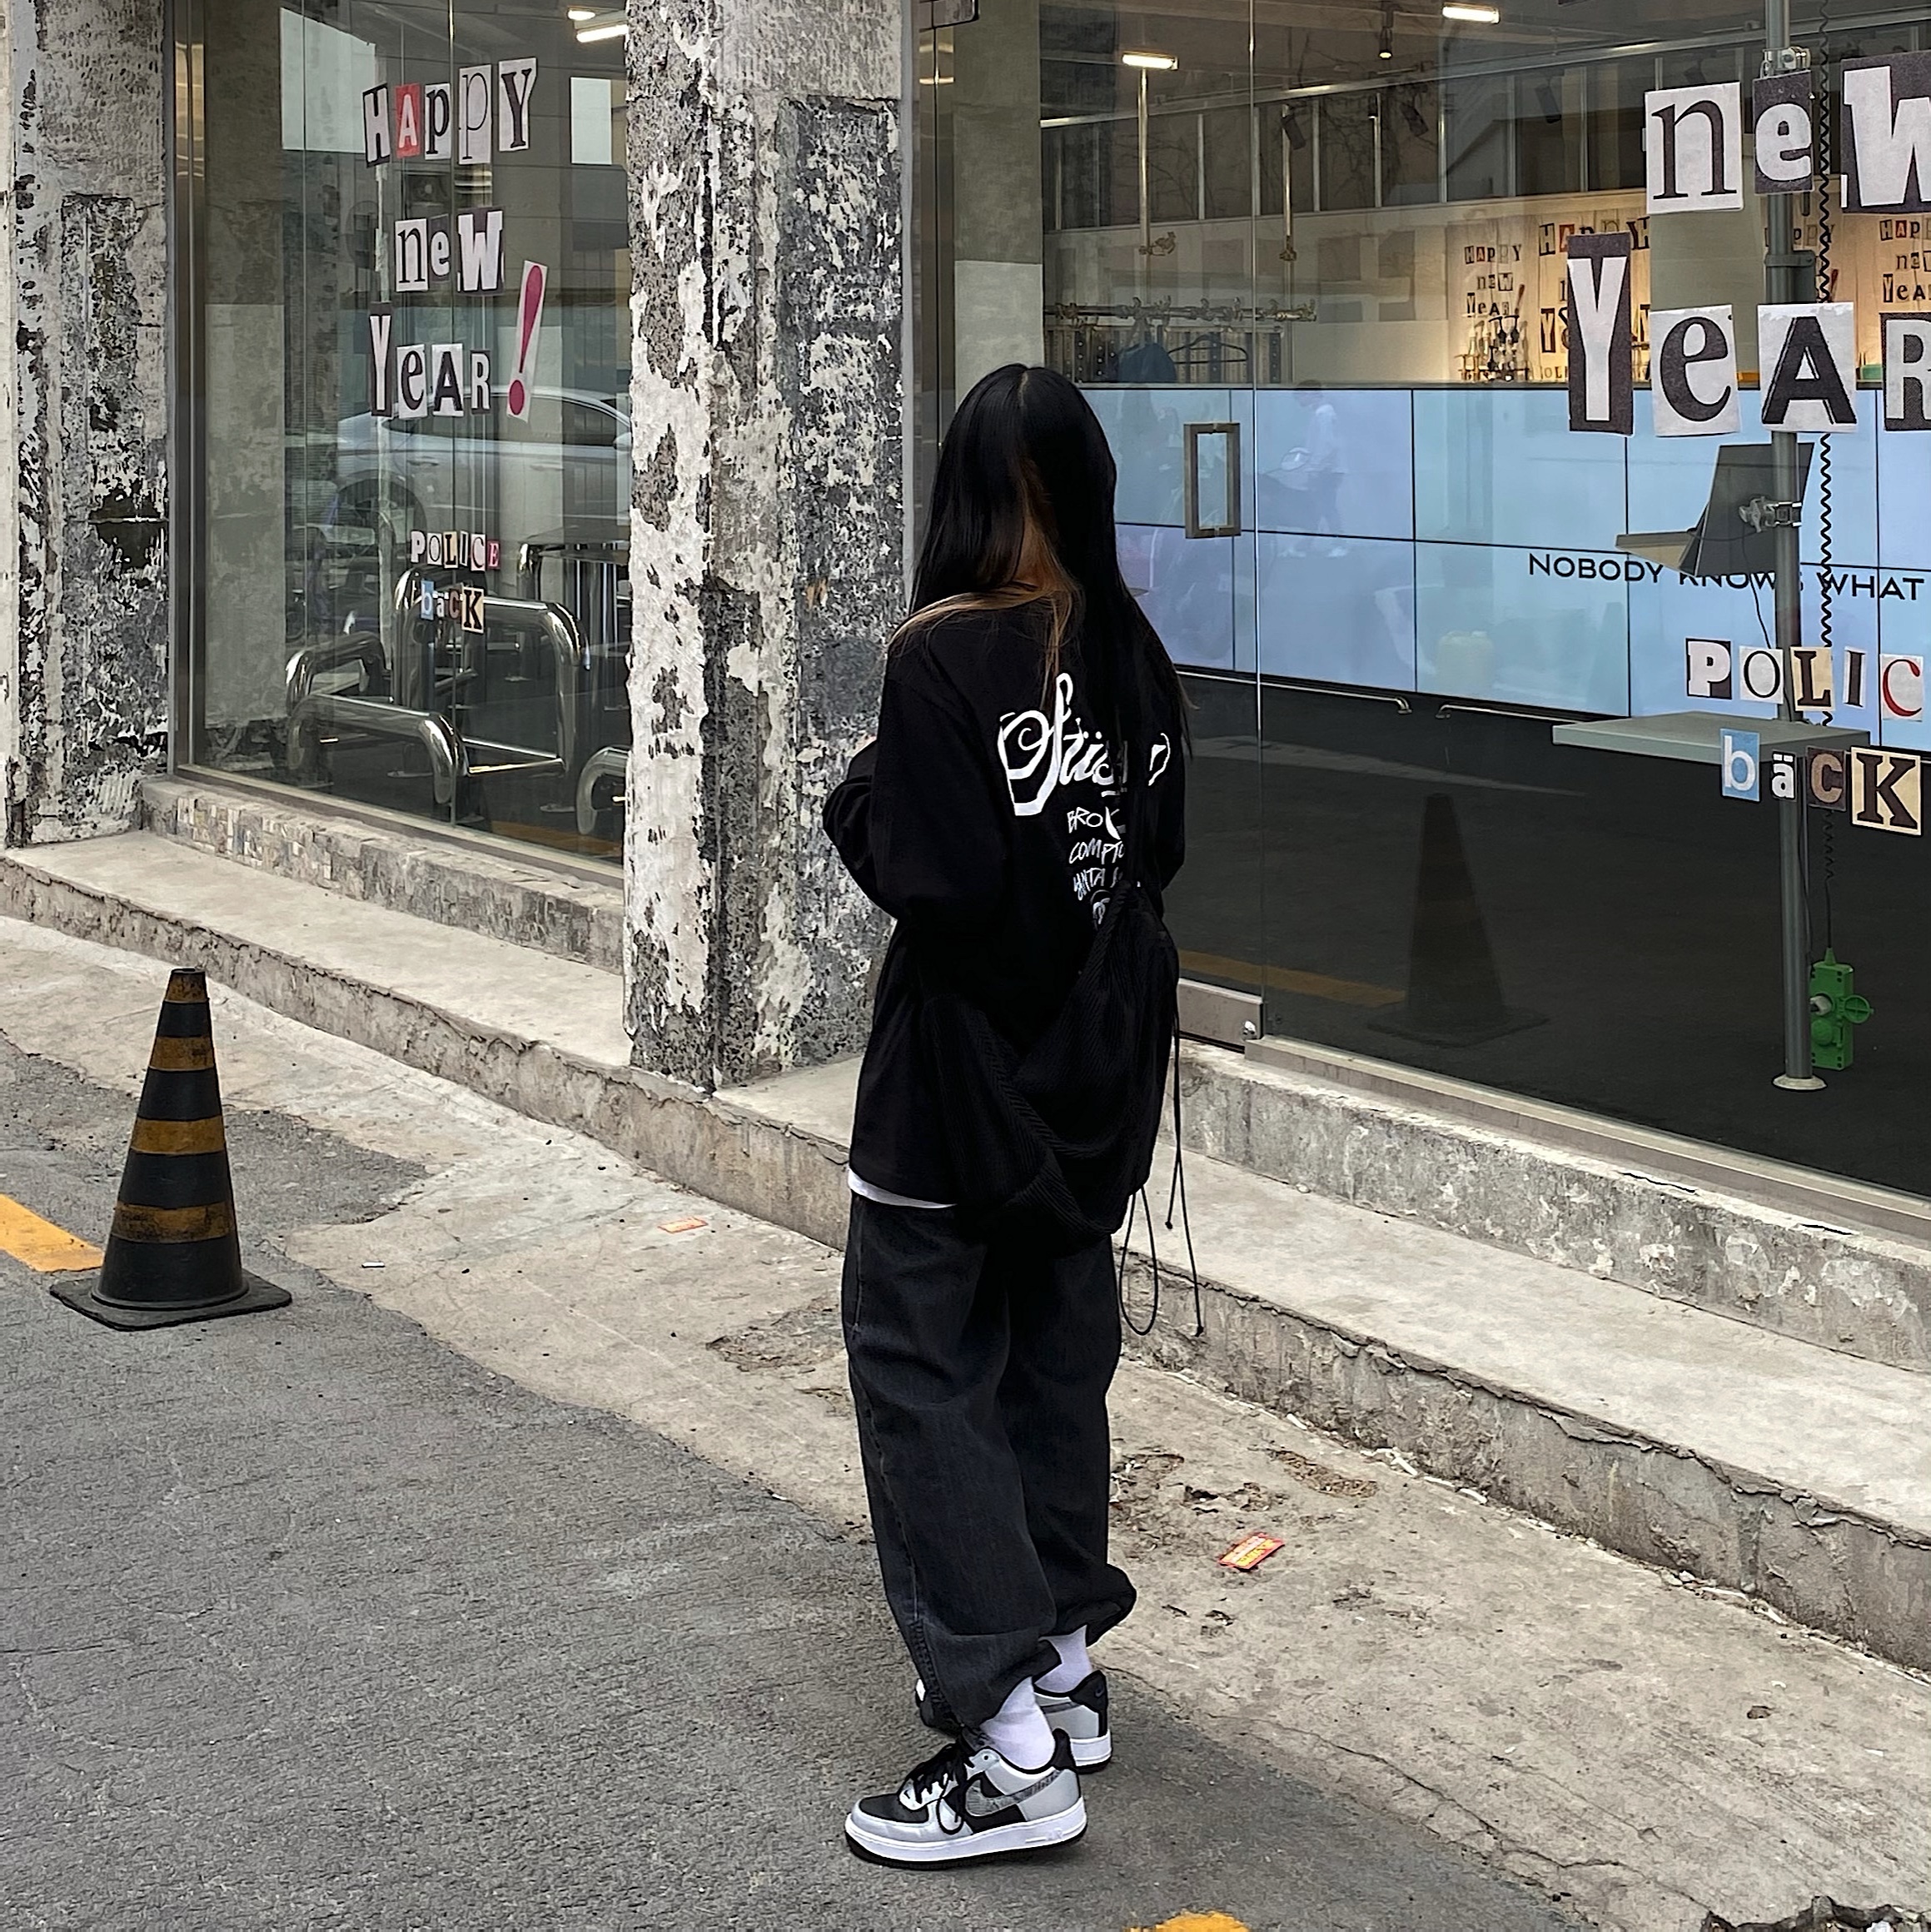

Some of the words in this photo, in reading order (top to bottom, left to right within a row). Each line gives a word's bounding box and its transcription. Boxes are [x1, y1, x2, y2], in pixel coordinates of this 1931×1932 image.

[411, 530, 499, 569] POLICE
[1529, 553, 1664, 583] NOBODY
[1816, 572, 1925, 600] WHAT
[1688, 641, 1923, 717] POLIC
